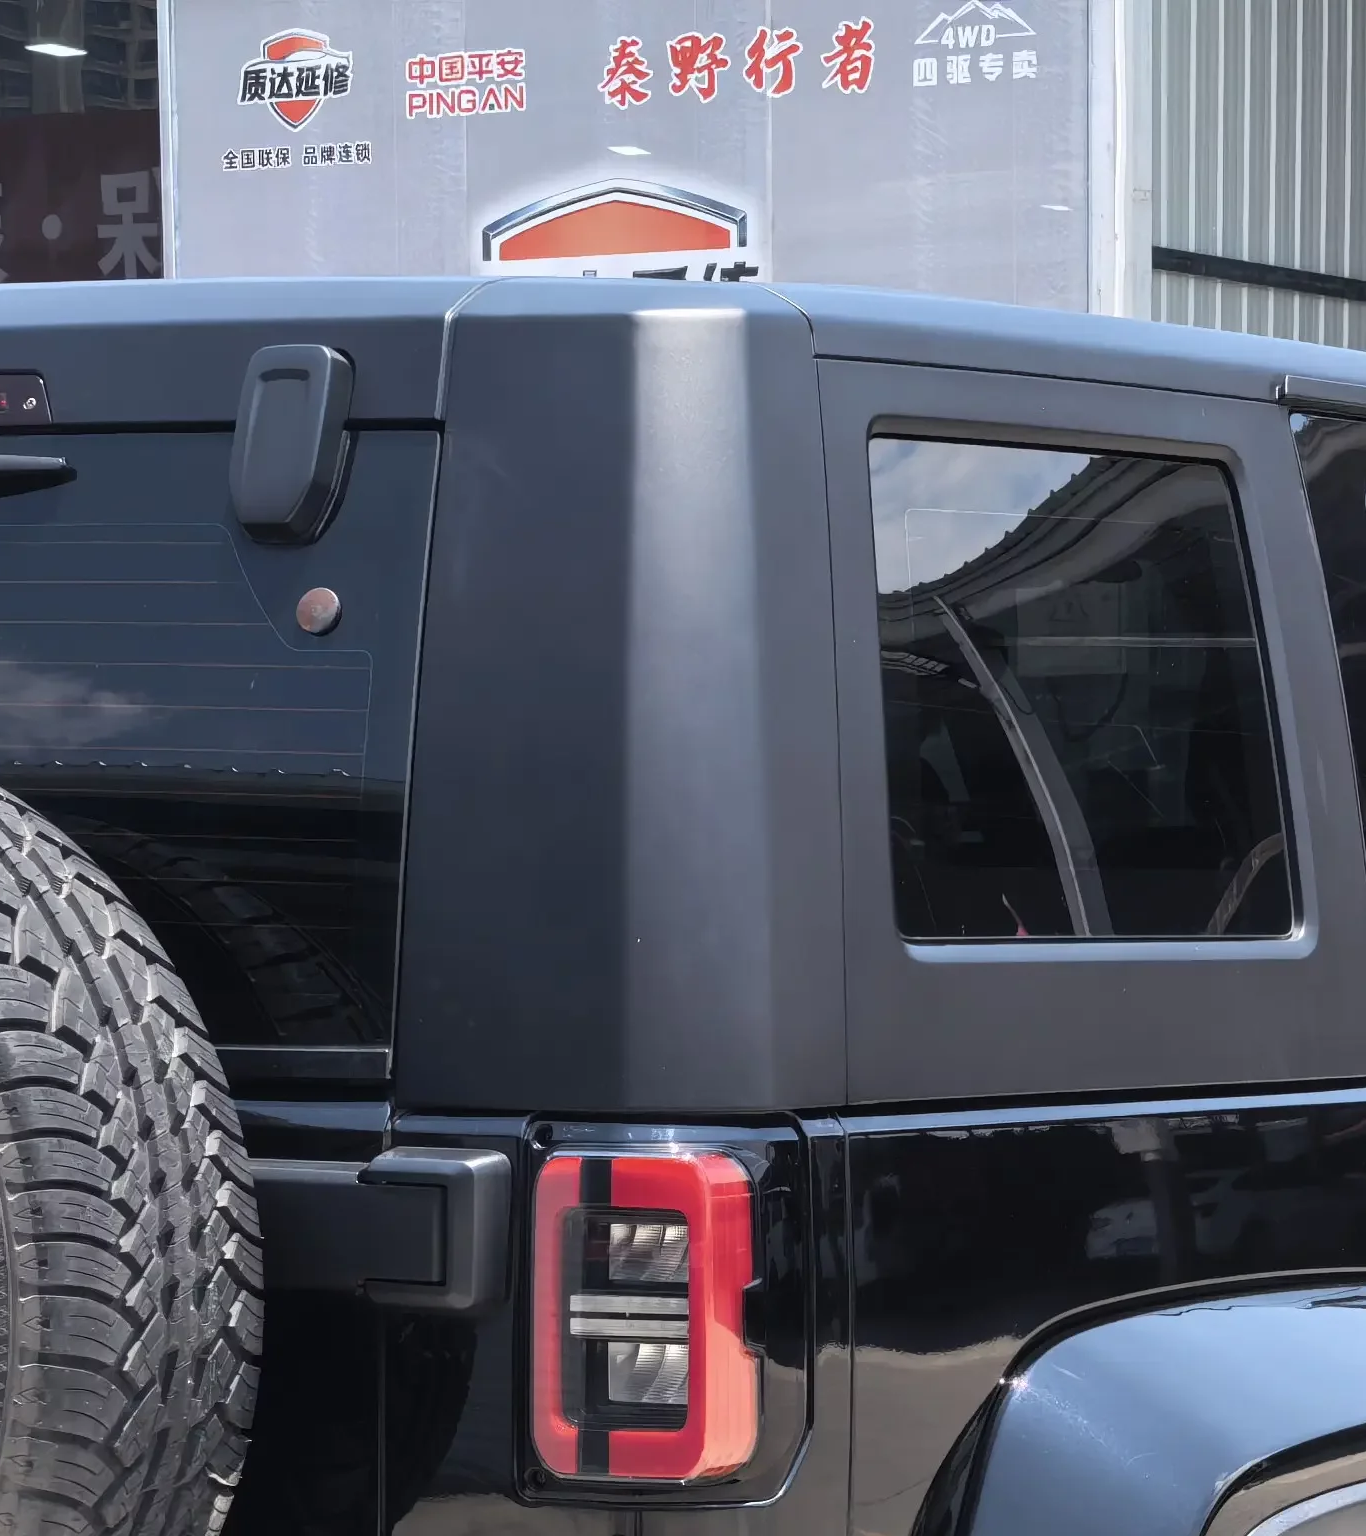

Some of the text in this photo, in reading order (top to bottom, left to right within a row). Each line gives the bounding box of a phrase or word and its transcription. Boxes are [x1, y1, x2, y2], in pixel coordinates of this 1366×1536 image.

[940, 25, 996, 49] 4WD
[408, 51, 524, 83] 中国平安
[601, 20, 874, 106] 秦野行者
[913, 51, 1038, 86] 四驱专卖
[240, 61, 352, 102] 质达延修
[223, 143, 371, 170] 全国联保 品牌连锁
